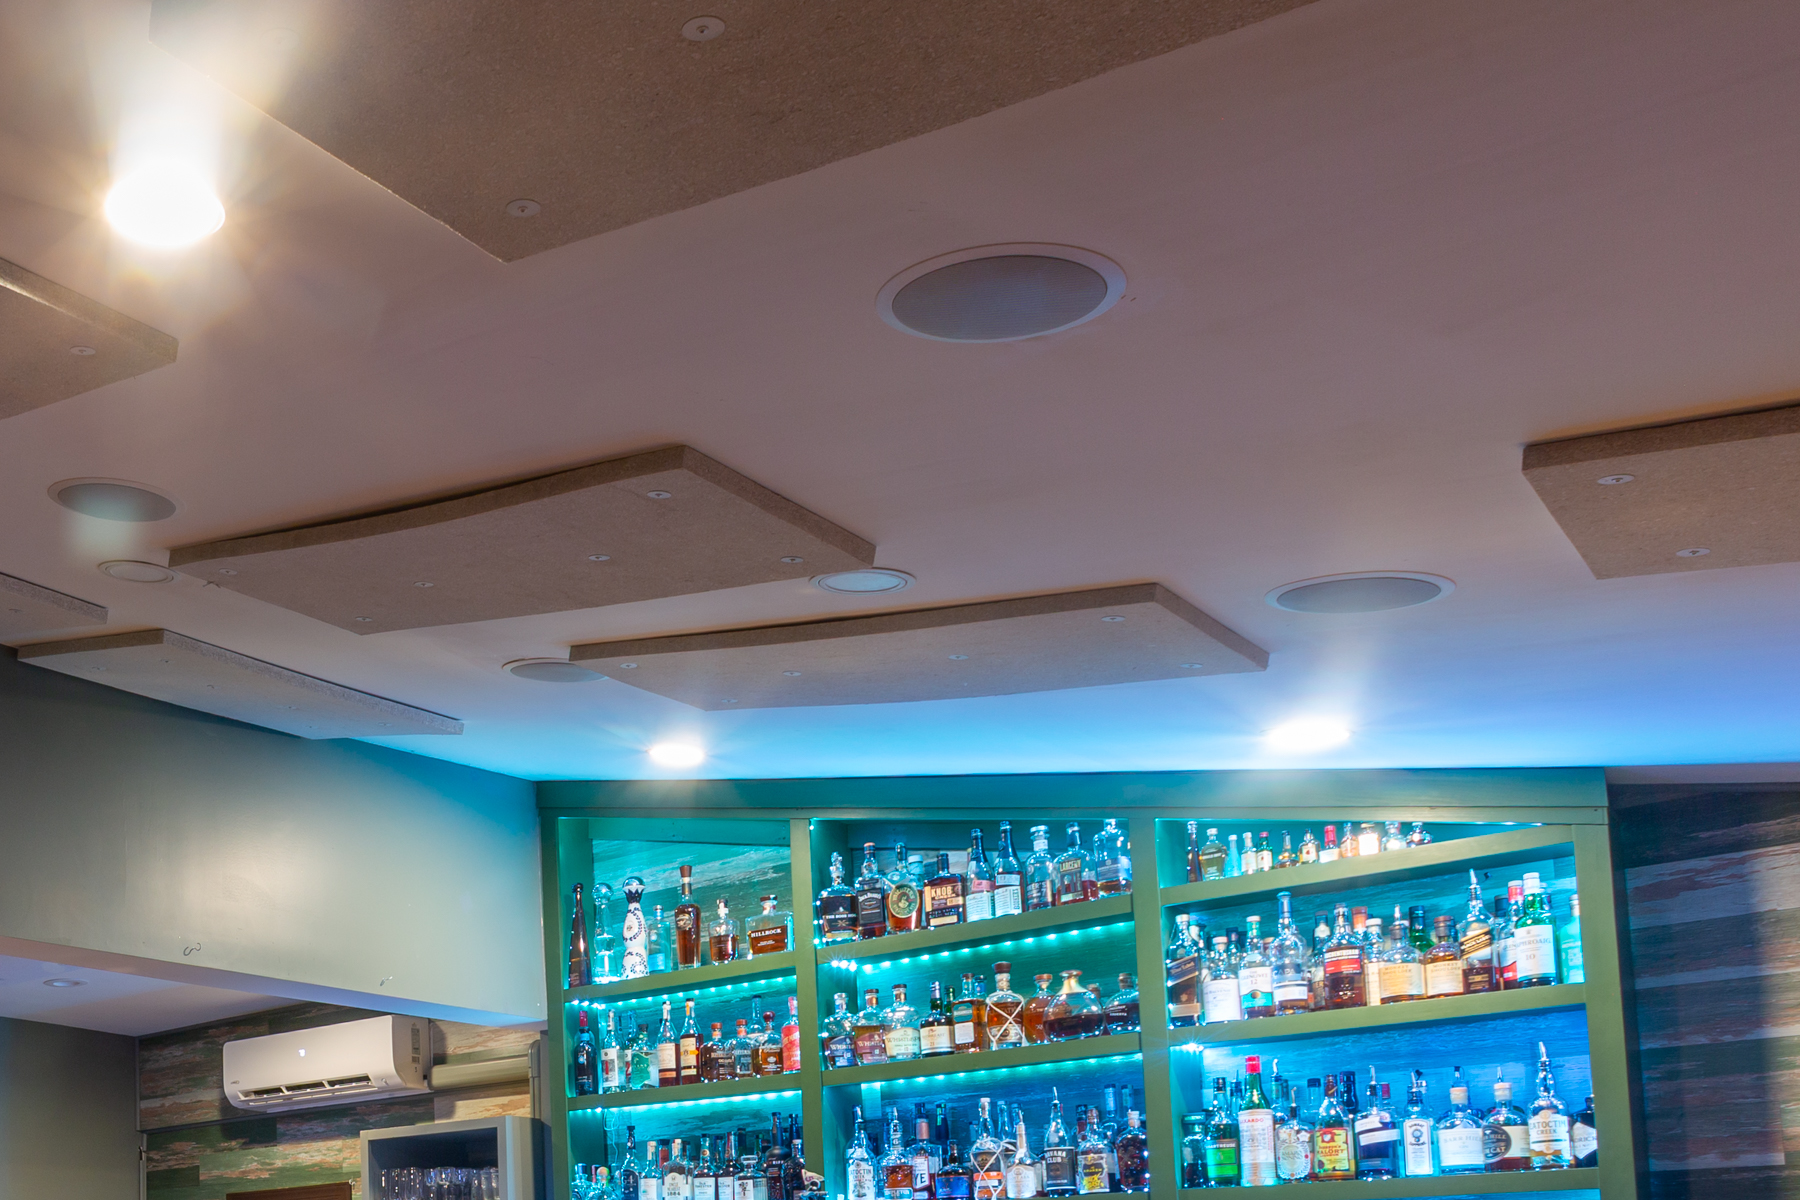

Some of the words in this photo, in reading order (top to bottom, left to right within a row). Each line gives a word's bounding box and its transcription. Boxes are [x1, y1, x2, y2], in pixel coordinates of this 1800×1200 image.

[931, 886, 952, 897] KNOB
[751, 928, 781, 937] HILLROCK
[914, 1172, 926, 1185] YE
